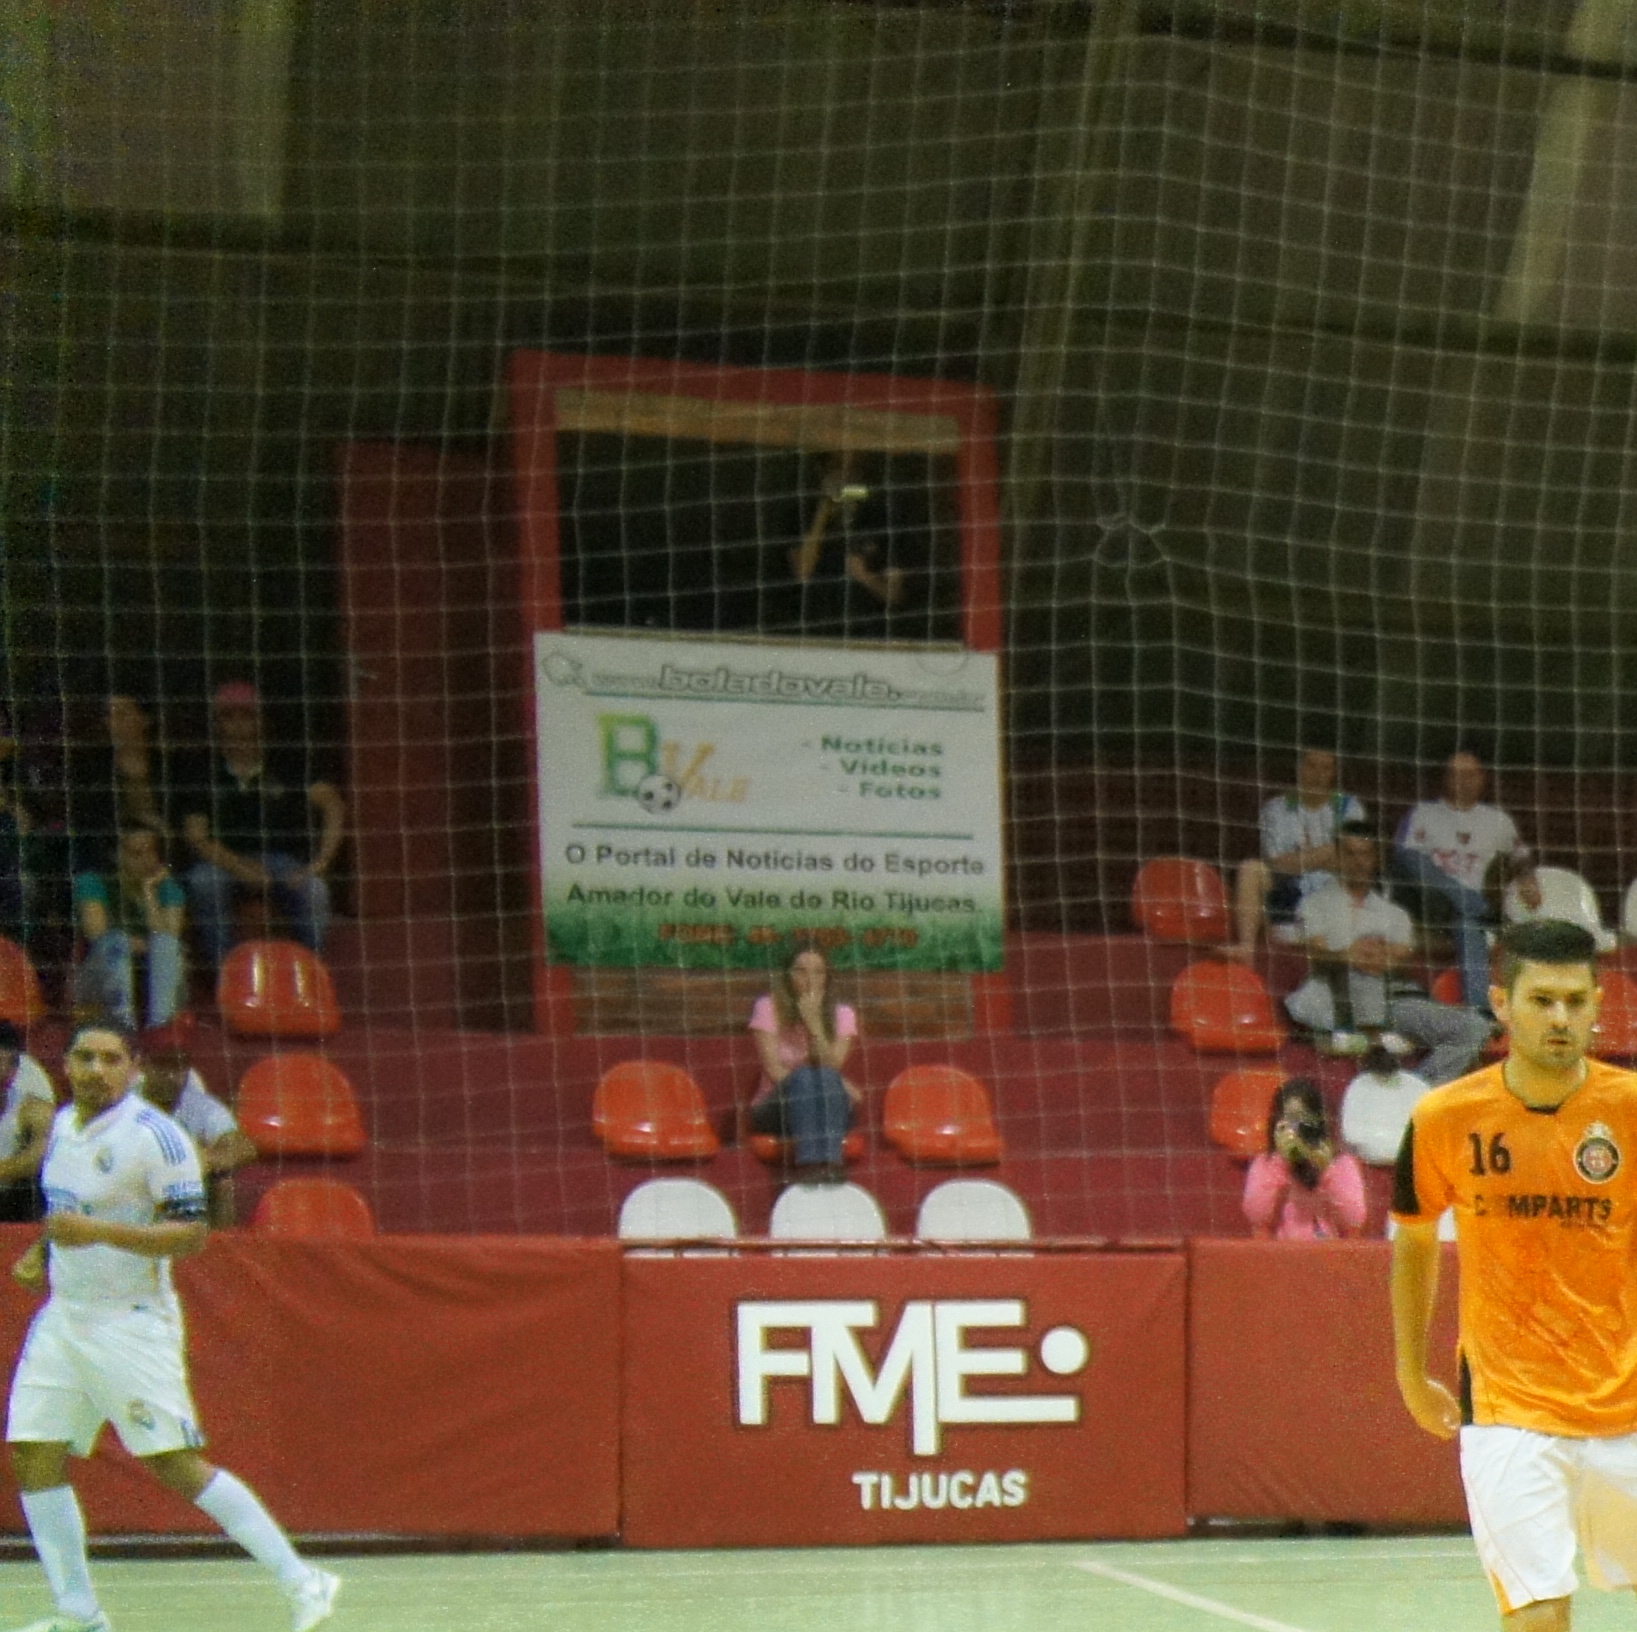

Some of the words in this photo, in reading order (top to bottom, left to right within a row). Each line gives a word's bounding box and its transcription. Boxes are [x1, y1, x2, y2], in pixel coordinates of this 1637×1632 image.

[566, 843, 586, 865] O
[596, 845, 676, 866] Portal
[685, 848, 717, 868] de
[843, 852, 875, 873] do
[884, 853, 985, 877] Esporte
[566, 884, 674, 906] Amador
[683, 887, 717, 908] do
[725, 886, 781, 908] Vale
[789, 890, 822, 910] do
[832, 890, 875, 911] Rio
[1469, 1132, 1512, 1176] 16
[1474, 1193, 1613, 1221] CMPARTS
[737, 1301, 1080, 1456] FME
[851, 1469, 1029, 1510] TIJUCAS
